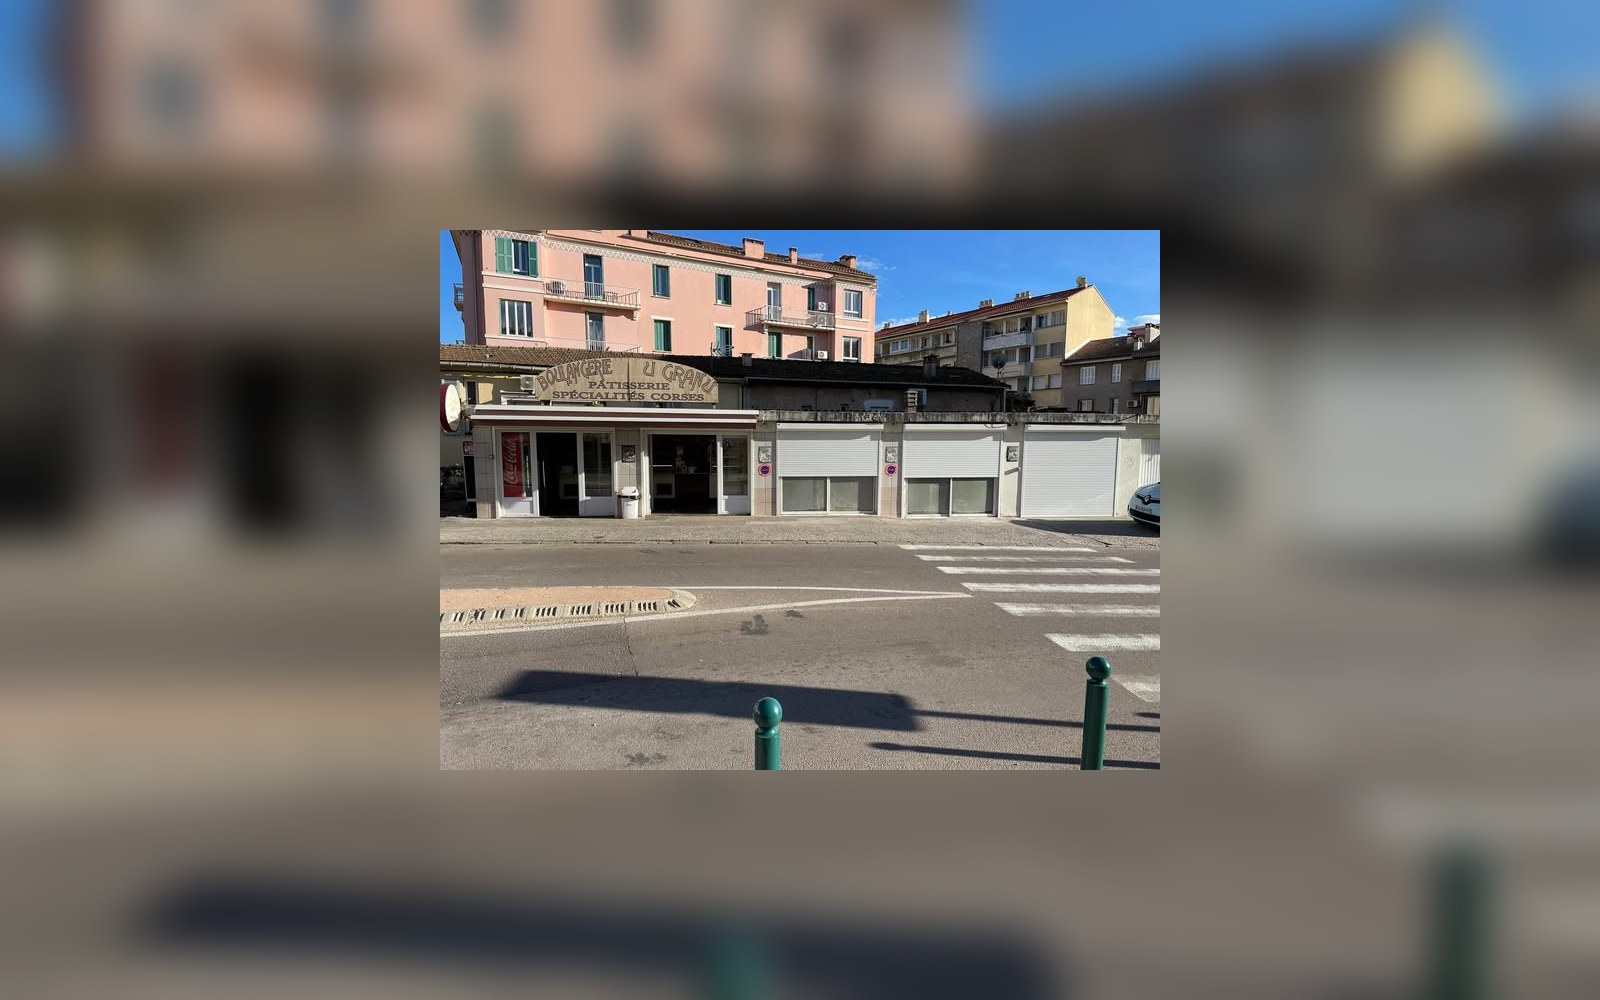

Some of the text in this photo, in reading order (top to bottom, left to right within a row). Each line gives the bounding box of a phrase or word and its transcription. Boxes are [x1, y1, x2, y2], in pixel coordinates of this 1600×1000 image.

[536, 358, 613, 392] BOULANGERIE
[588, 380, 671, 391] PÂTISSERIE
[662, 363, 718, 395] GRANU
[552, 390, 705, 402] SPÉCIALITÉS CORSES
